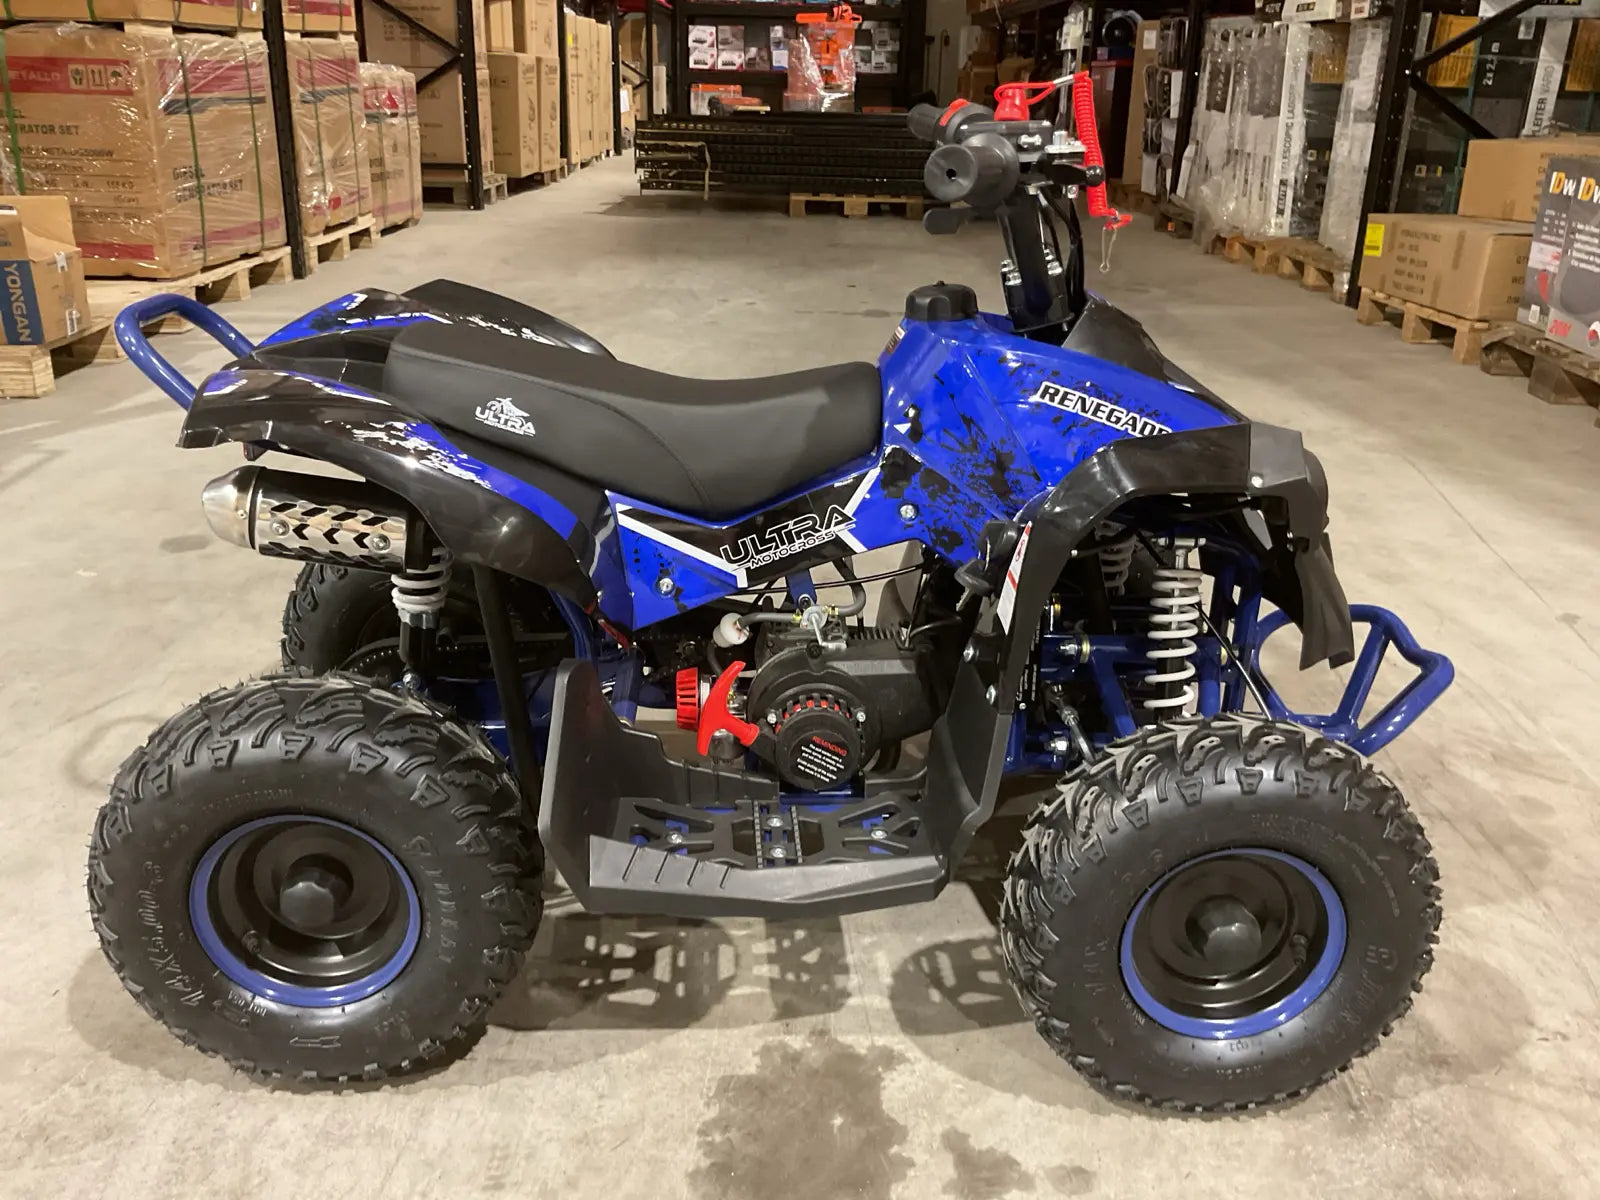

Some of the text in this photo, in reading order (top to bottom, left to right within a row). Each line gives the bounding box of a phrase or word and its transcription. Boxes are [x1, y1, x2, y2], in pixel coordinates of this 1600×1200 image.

[3, 262, 32, 343] YONGAN
[475, 406, 536, 435] ULTRA
[719, 504, 857, 565] ULTRA
[748, 530, 836, 570] MOTOCROSS
